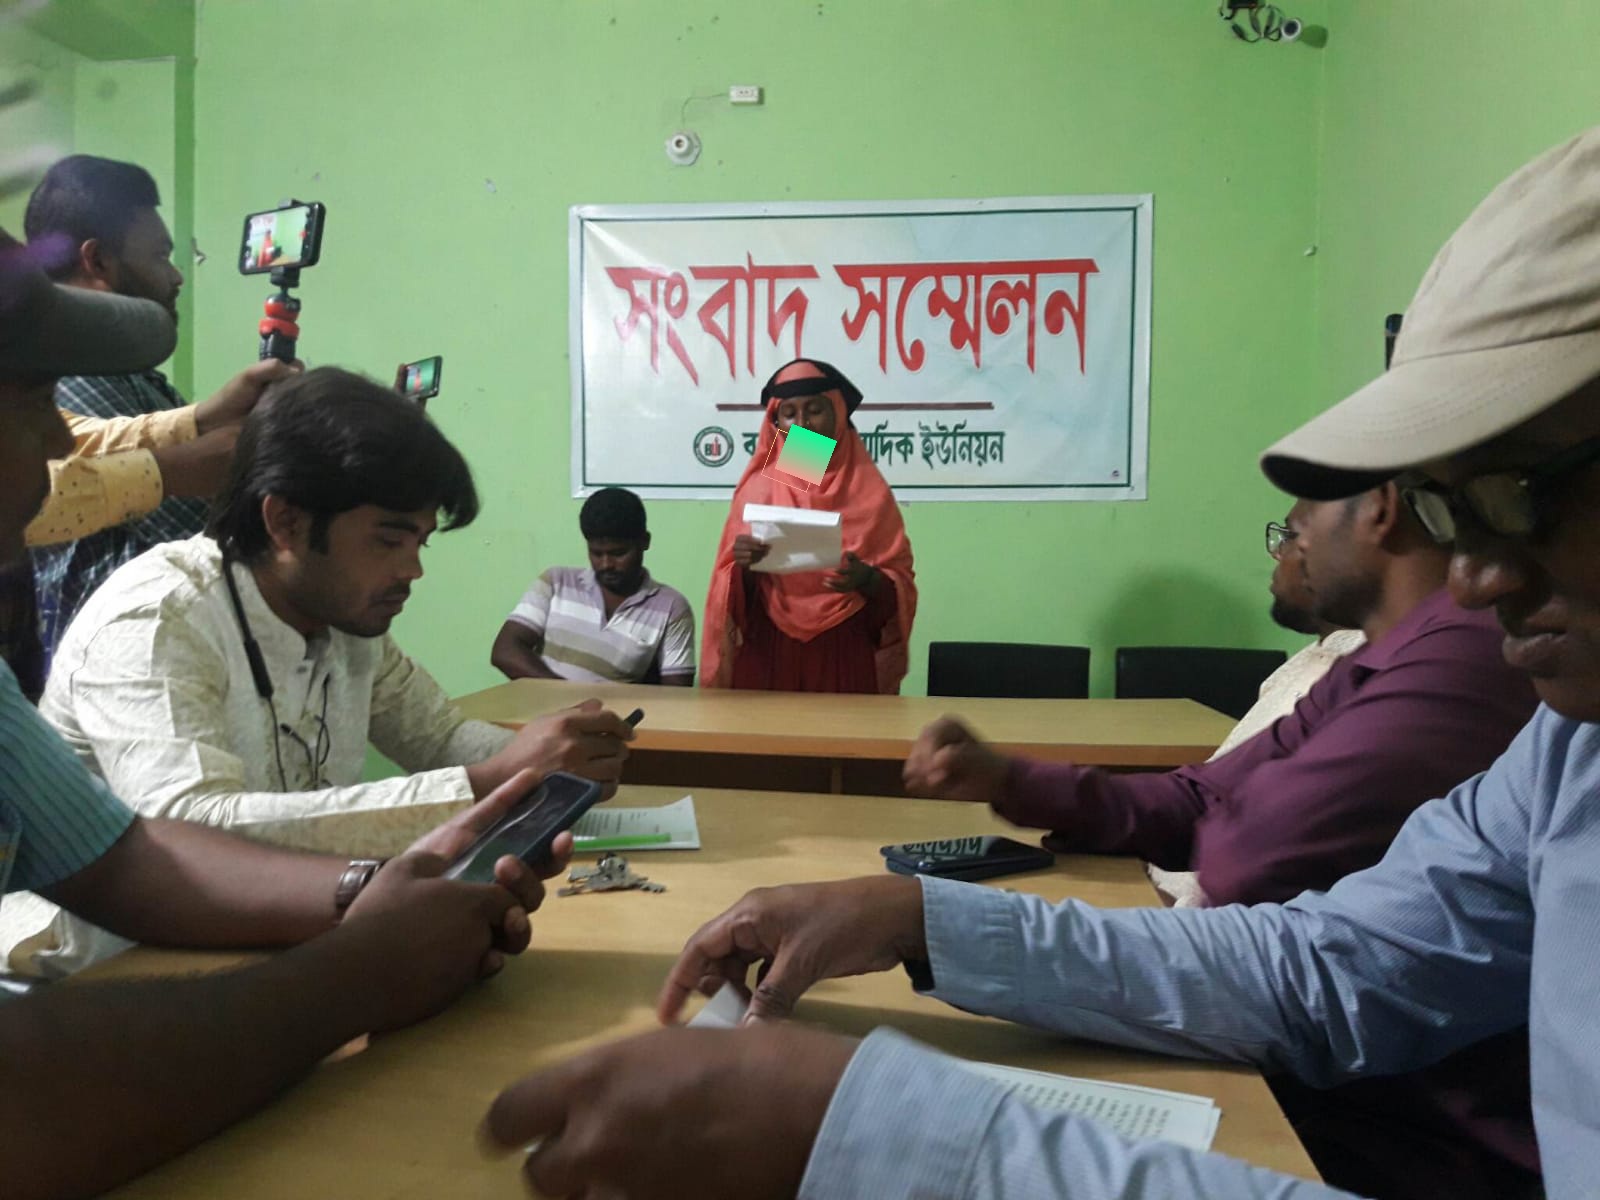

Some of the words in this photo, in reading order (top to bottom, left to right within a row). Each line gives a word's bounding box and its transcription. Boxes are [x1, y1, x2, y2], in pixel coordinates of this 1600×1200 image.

[604, 251, 820, 387] সংবাদ
[832, 258, 1100, 375] সম্মেলন
[918, 419, 1005, 470] ইউনিয়ন
